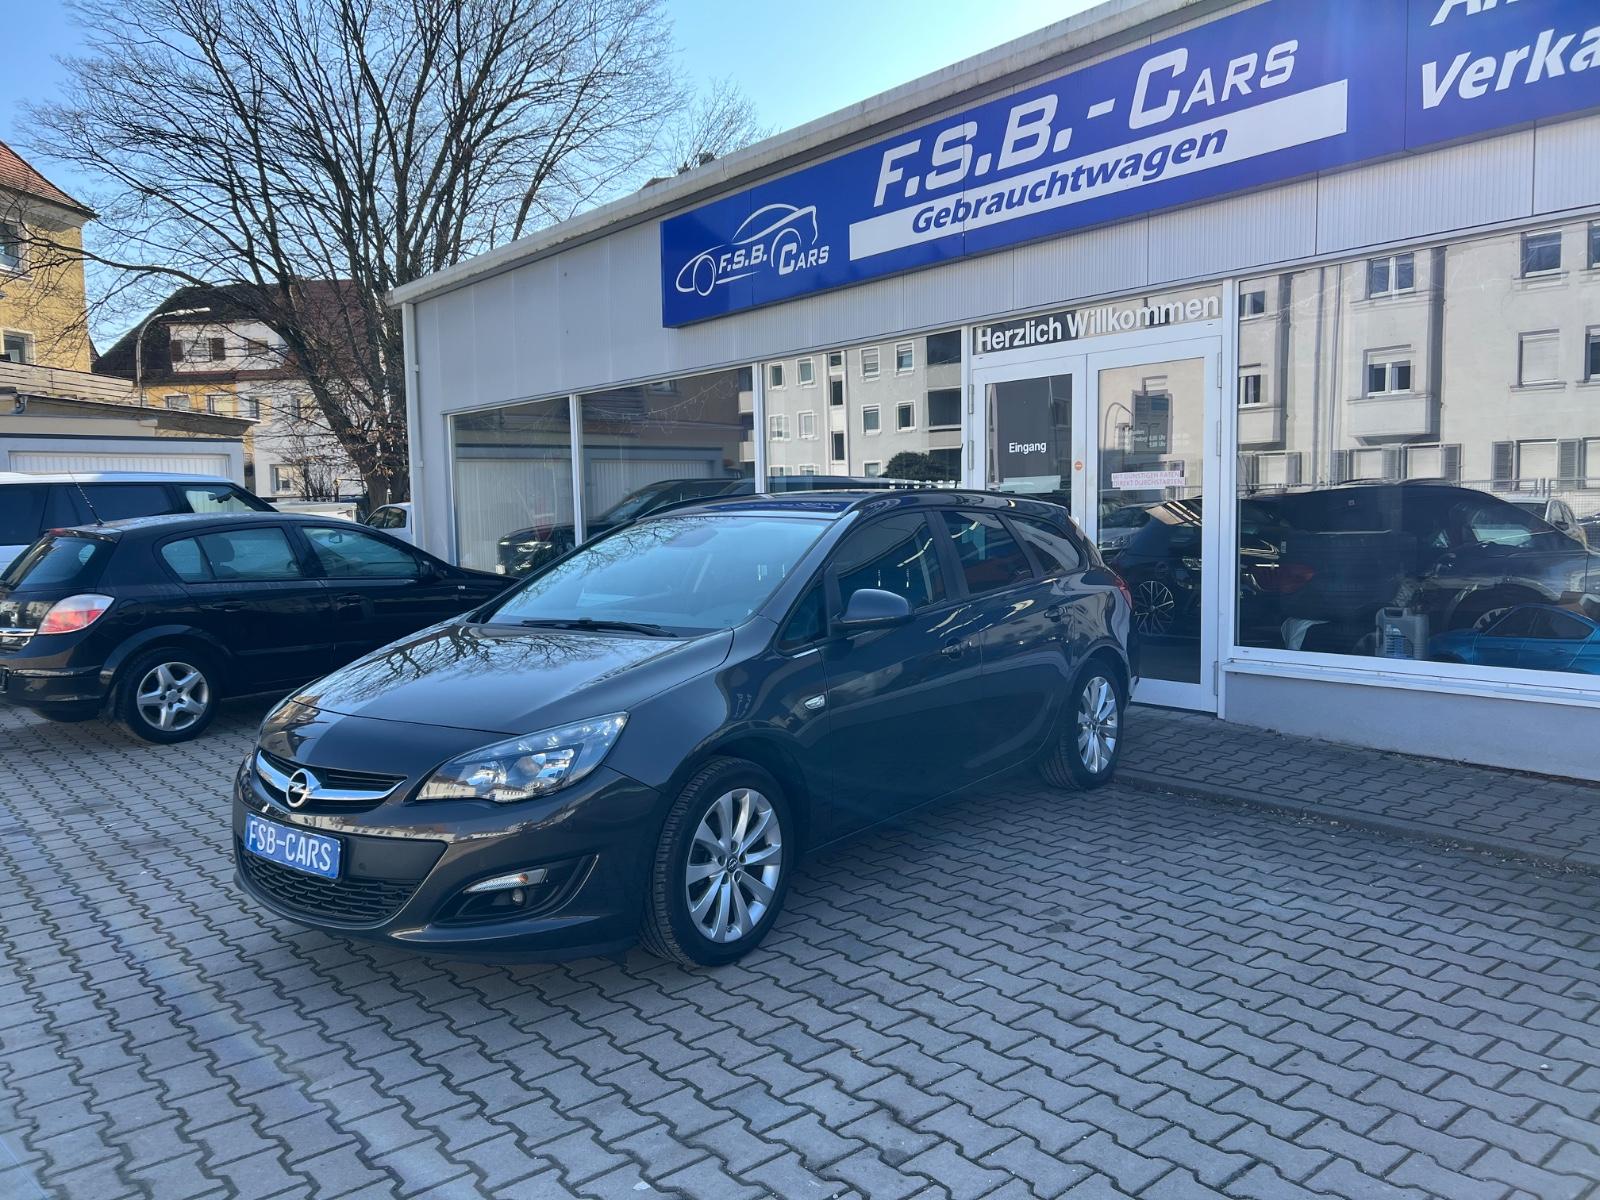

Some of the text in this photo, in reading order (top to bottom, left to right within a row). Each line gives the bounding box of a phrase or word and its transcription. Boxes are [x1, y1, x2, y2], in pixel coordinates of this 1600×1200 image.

[911, 127, 1229, 234] Gebrauchtwagen
[718, 243, 768, 274] F.S.B.
[976, 294, 1221, 352] Herzlich Willkommen
[1008, 440, 1047, 455] Eingang
[248, 820, 332, 872] FSB-CARS
